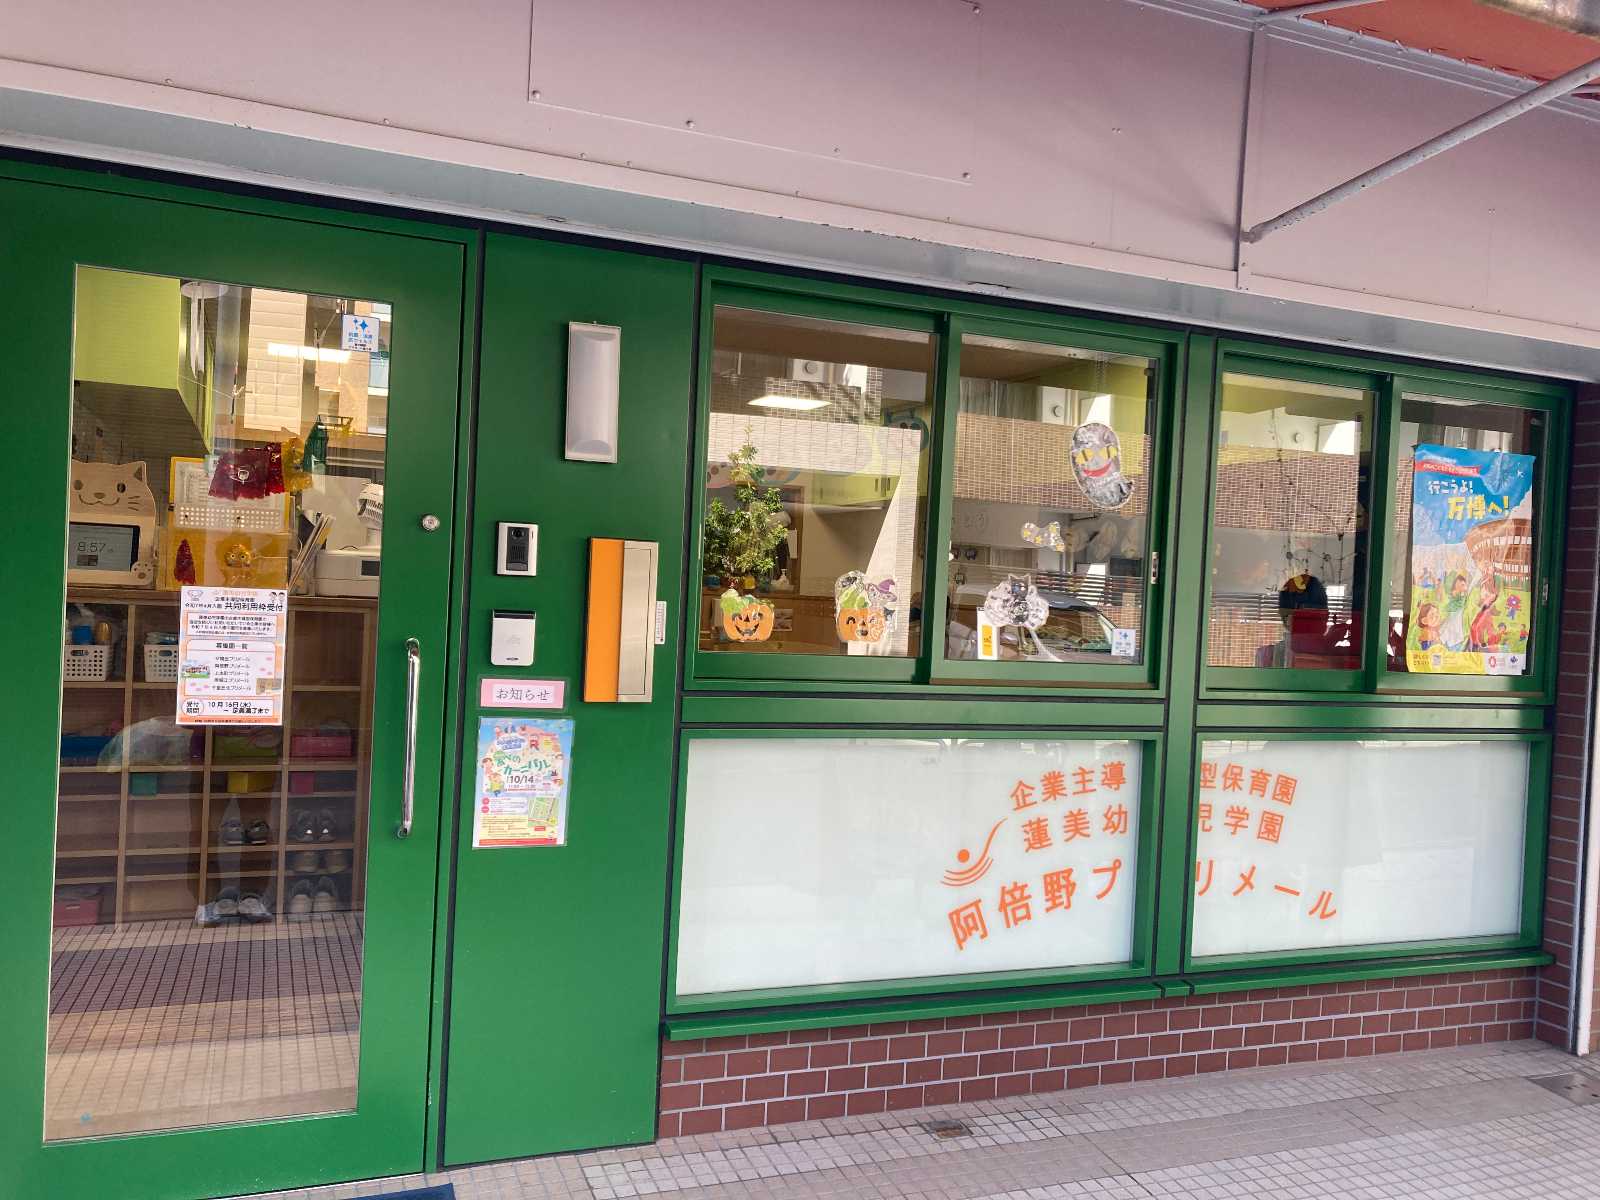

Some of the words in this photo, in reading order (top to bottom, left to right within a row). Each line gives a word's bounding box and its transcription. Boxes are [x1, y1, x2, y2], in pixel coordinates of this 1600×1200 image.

[496, 687, 551, 701] お知らせ
[1010, 761, 1126, 811] 企業主導
[1021, 803, 1128, 852] 蓮美幼
[948, 858, 1122, 951] 阿倍野プ
